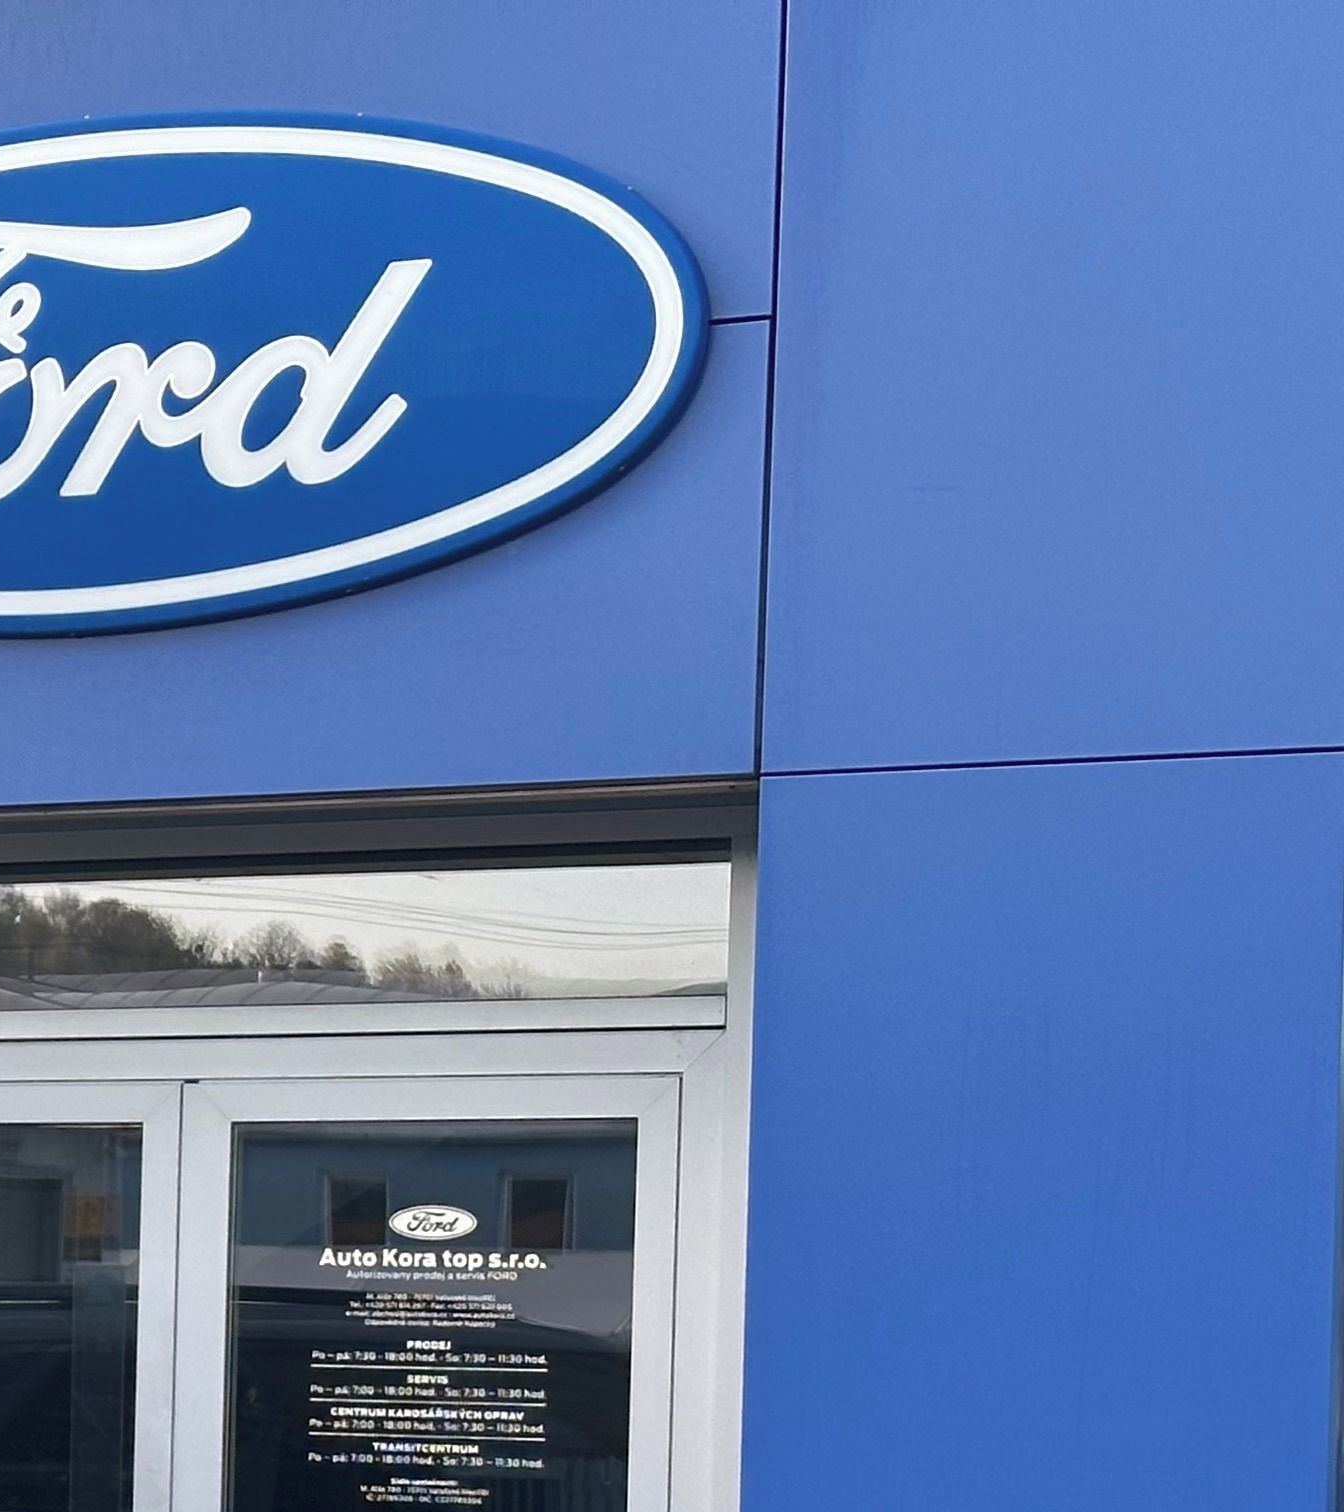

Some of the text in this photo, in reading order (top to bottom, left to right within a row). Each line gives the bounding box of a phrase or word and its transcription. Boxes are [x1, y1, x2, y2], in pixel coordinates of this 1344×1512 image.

[407, 1211, 459, 1232] Ford
[318, 1247, 547, 1271] Auto Kora top s.r.o.
[455, 1271, 485, 1280] servis
[487, 1270, 518, 1281] FORD
[406, 1340, 451, 1350] PRODEJ
[407, 1375, 448, 1384] SERVIS
[330, 1407, 386, 1416] CENTRUM
[484, 1411, 524, 1420] OPRAV
